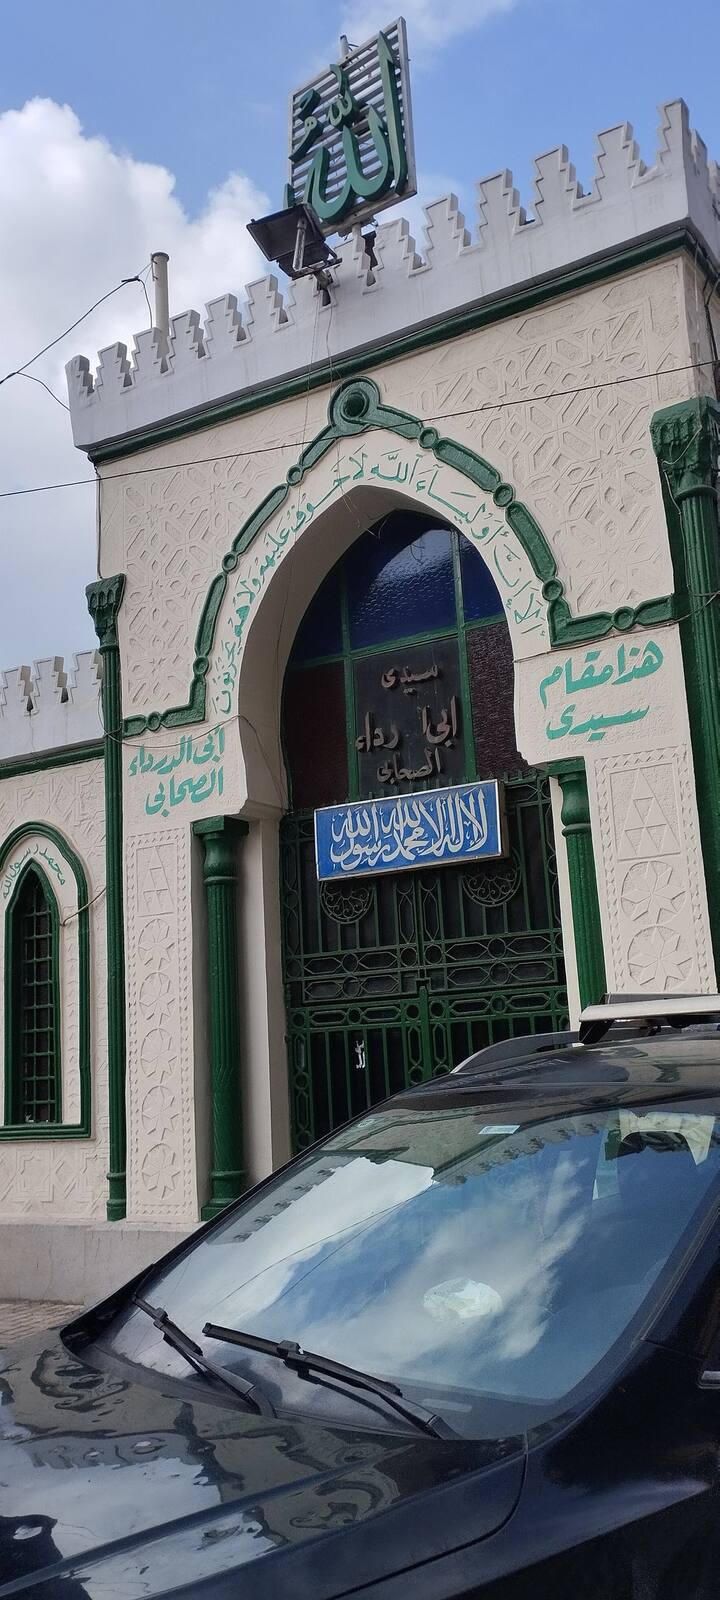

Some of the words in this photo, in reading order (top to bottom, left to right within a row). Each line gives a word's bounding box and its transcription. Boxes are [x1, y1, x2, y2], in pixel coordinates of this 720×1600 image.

[283, 30, 408, 222] الله
[539, 649, 615, 711] مقام
[612, 639, 664, 686] هذا
[128, 734, 193, 777] الدرداء
